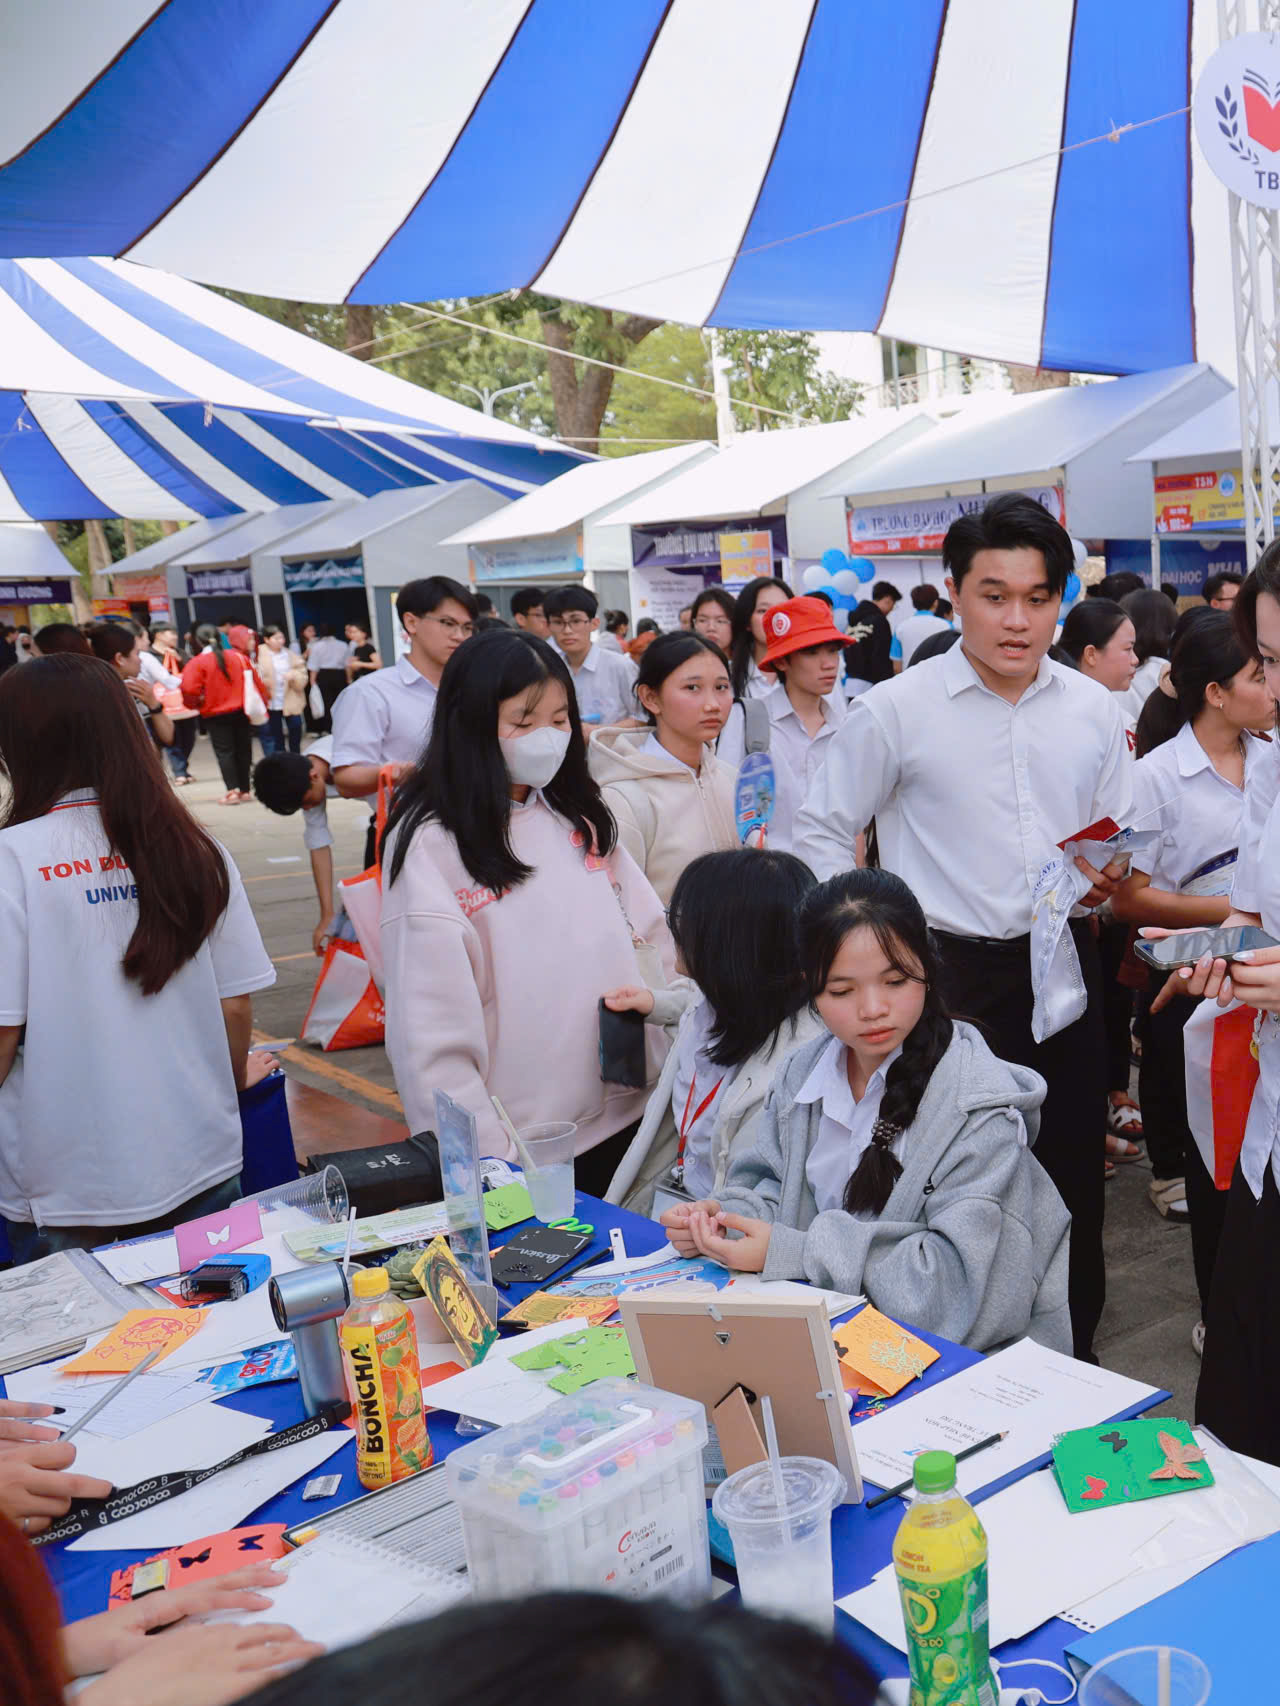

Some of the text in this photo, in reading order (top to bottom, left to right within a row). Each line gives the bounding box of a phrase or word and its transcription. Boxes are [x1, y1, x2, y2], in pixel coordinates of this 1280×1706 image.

[1195, 475, 1213, 487] TSN
[1180, 570, 1202, 585] HỌC
[38, 859, 93, 881] TON
[350, 1343, 384, 1453] BONCHA
